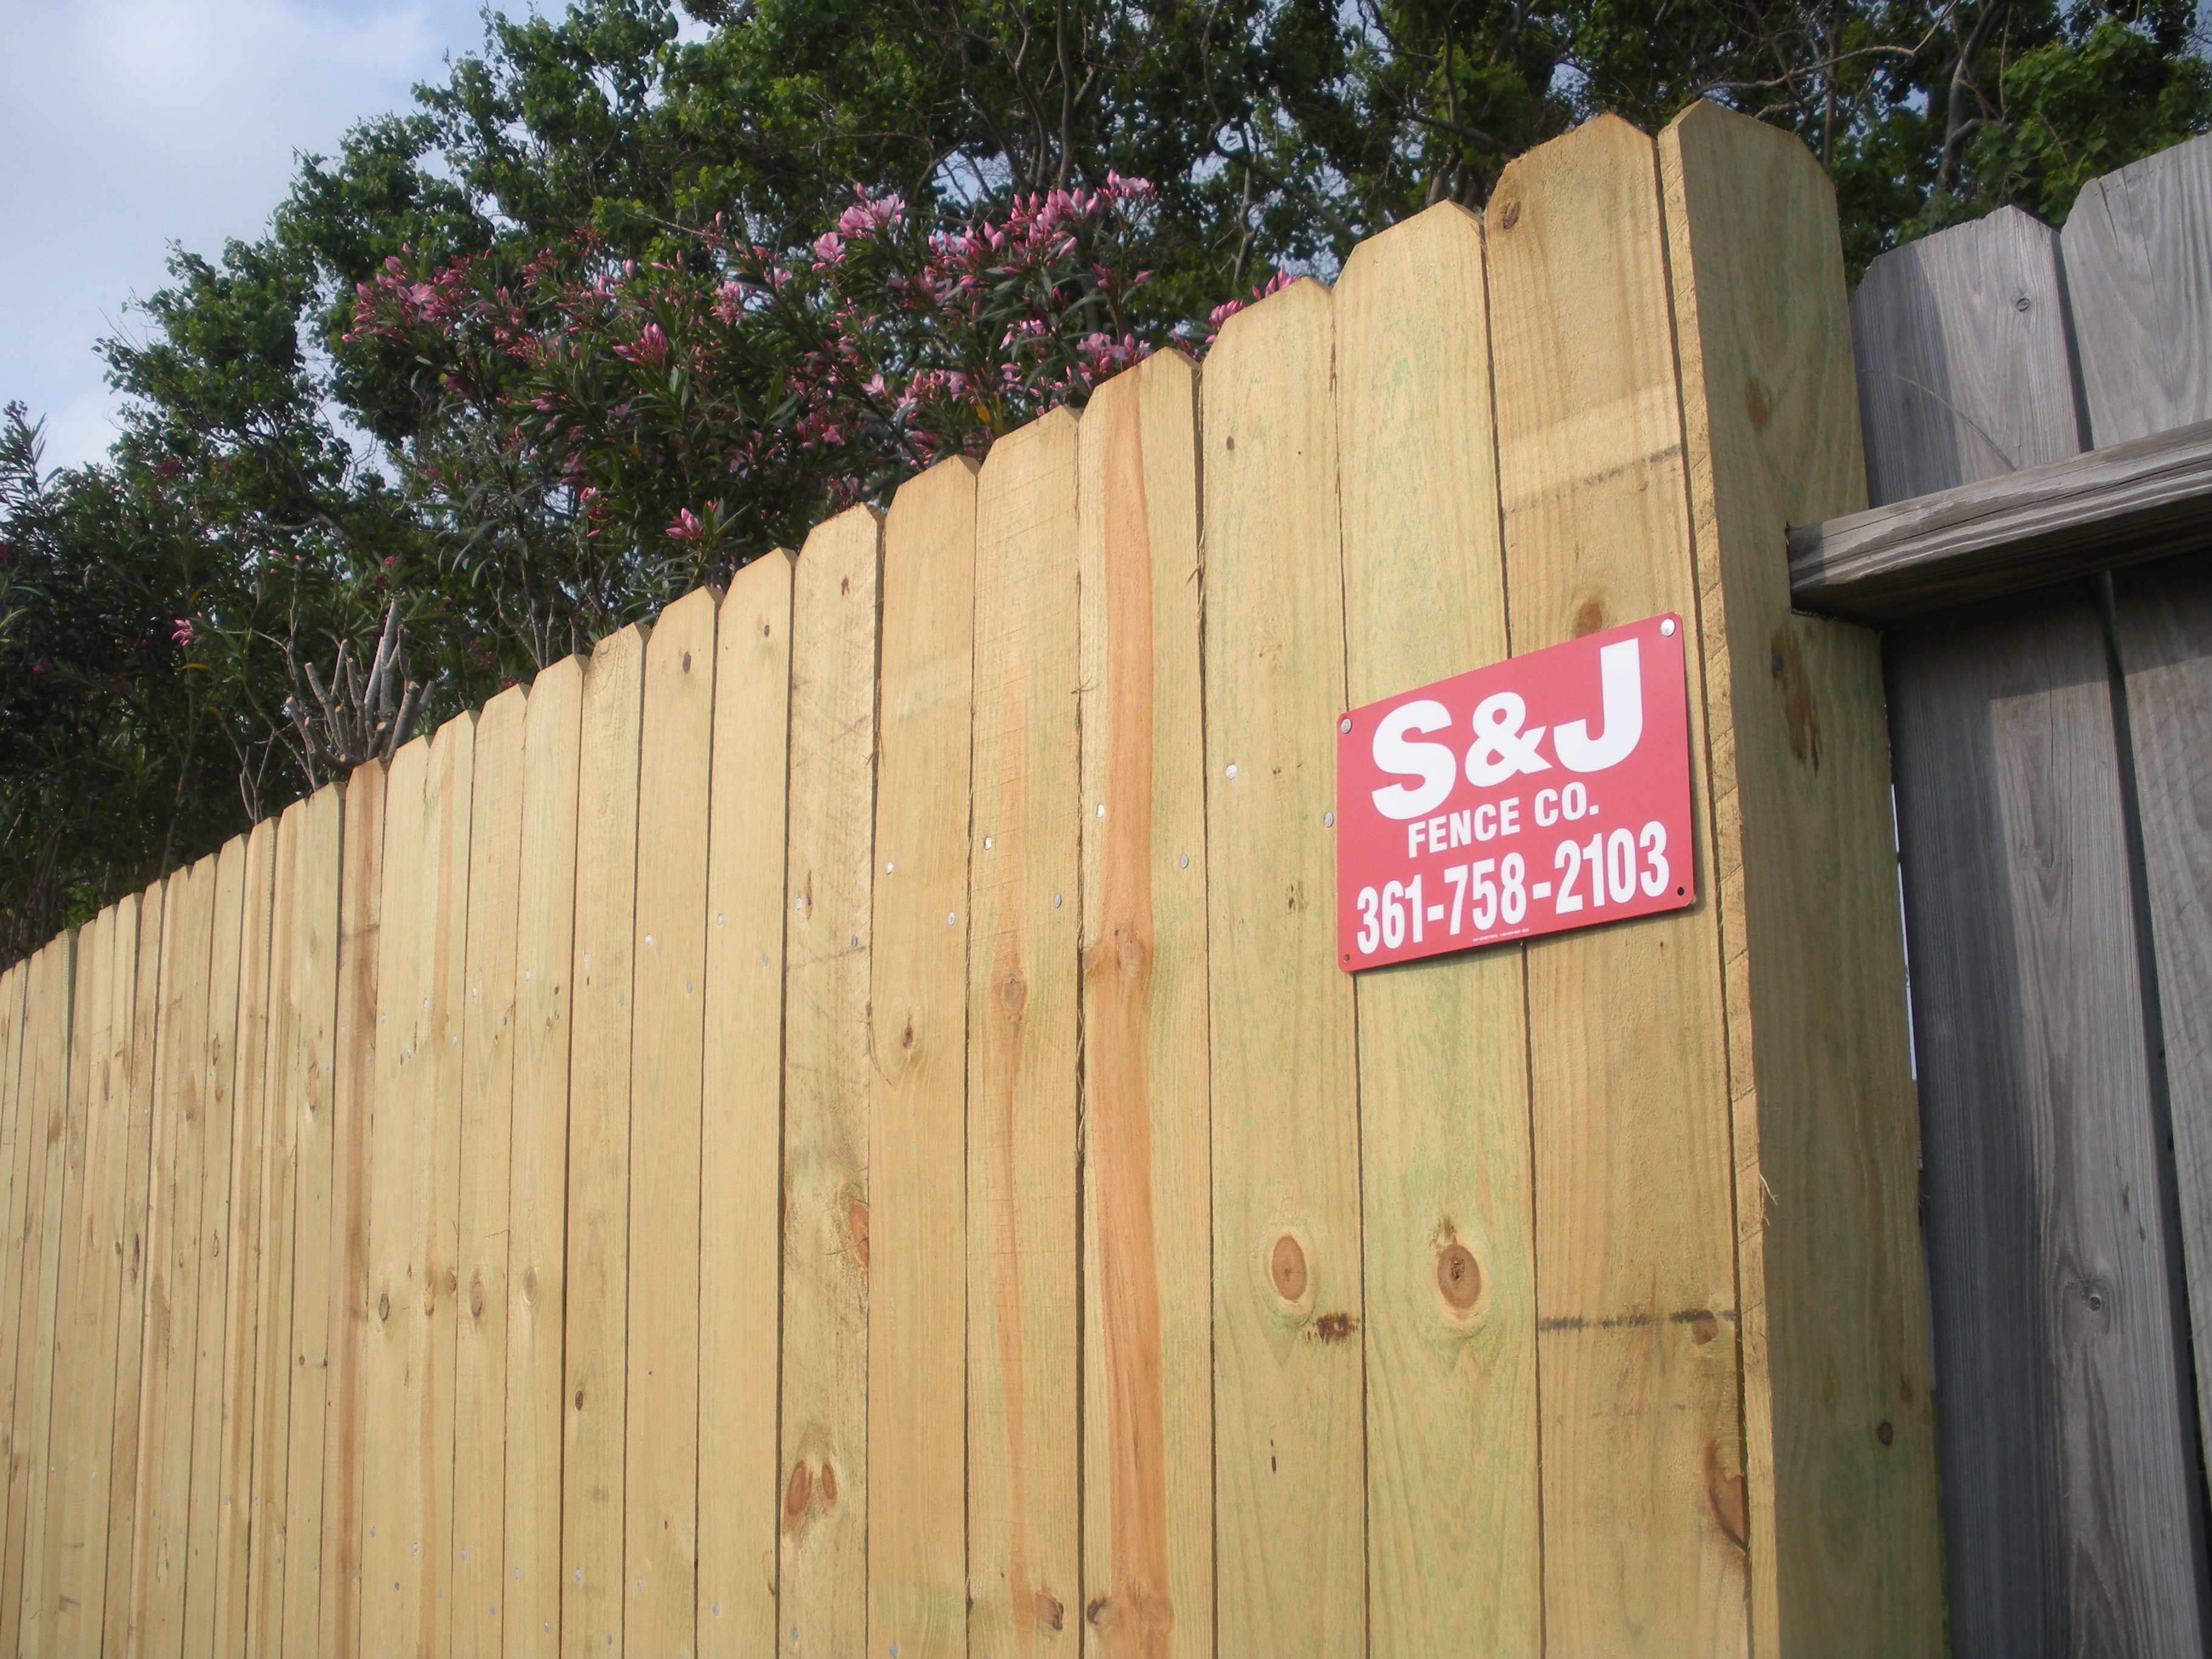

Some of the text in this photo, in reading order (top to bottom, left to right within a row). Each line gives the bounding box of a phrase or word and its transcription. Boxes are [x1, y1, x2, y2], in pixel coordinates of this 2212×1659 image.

[1371, 637, 1643, 820] S&J
[1356, 820, 1670, 954] 361-758-2103
[1408, 782, 1600, 859] FENCE CO.
